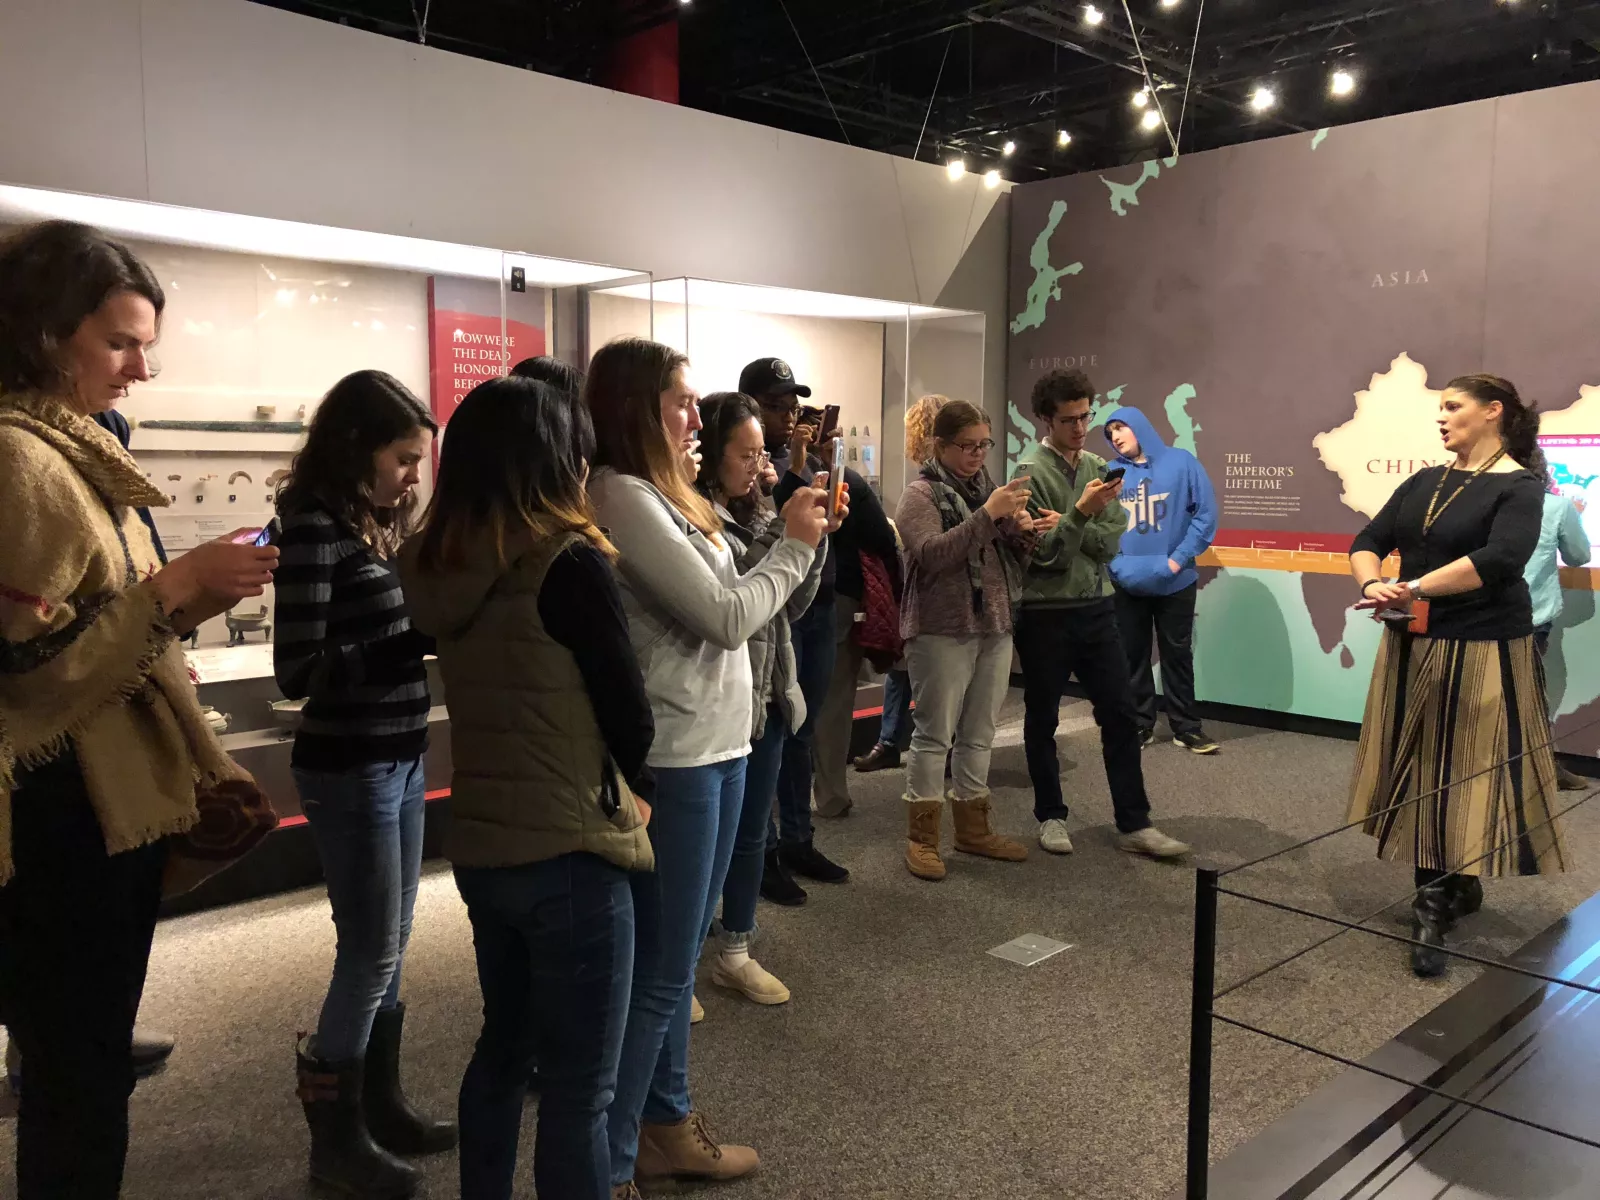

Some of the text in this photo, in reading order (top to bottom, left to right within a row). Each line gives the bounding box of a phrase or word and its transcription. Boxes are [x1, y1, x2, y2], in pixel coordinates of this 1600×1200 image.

[1371, 268, 1429, 288] ASIA
[453, 332, 516, 347] HOW WERE
[453, 348, 512, 361] THE DEAD
[1029, 354, 1099, 370] EUROPE
[1225, 453, 1252, 464] THE
[1226, 466, 1294, 476] EMPEROR'S
[1225, 479, 1282, 490] LIFETIME
[1135, 477, 1167, 534] UP
